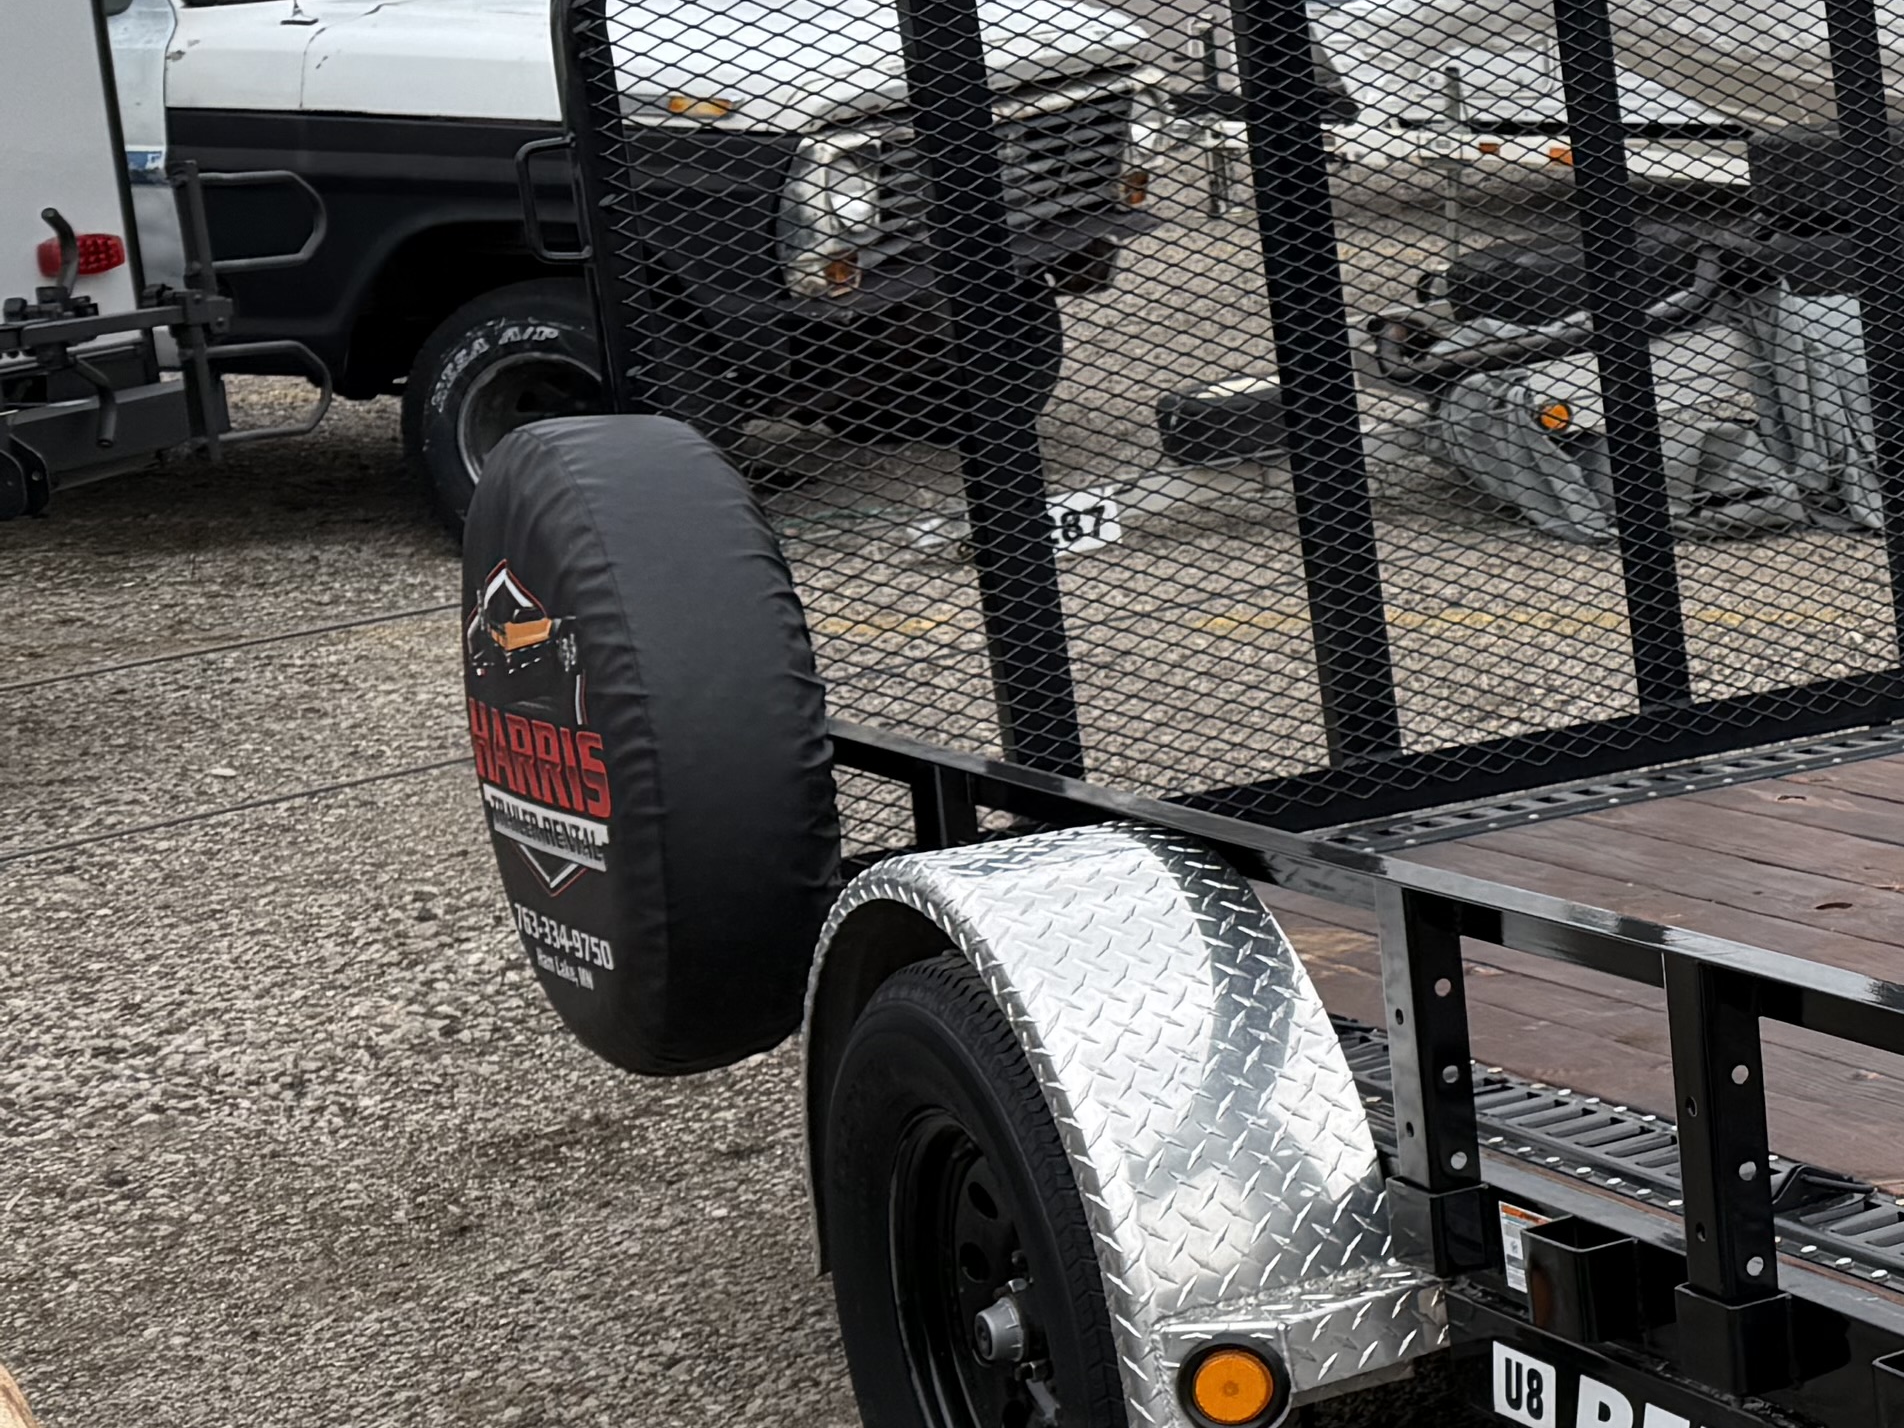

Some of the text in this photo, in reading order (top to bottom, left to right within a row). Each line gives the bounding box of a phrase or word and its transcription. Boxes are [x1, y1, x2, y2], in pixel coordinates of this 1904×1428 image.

[1049, 504, 1106, 544] 87
[469, 697, 612, 818] HARRIS
[542, 816, 603, 862] RENTAL
[514, 902, 614, 970] 763-334-9750
[1503, 1355, 1544, 1421] U8
